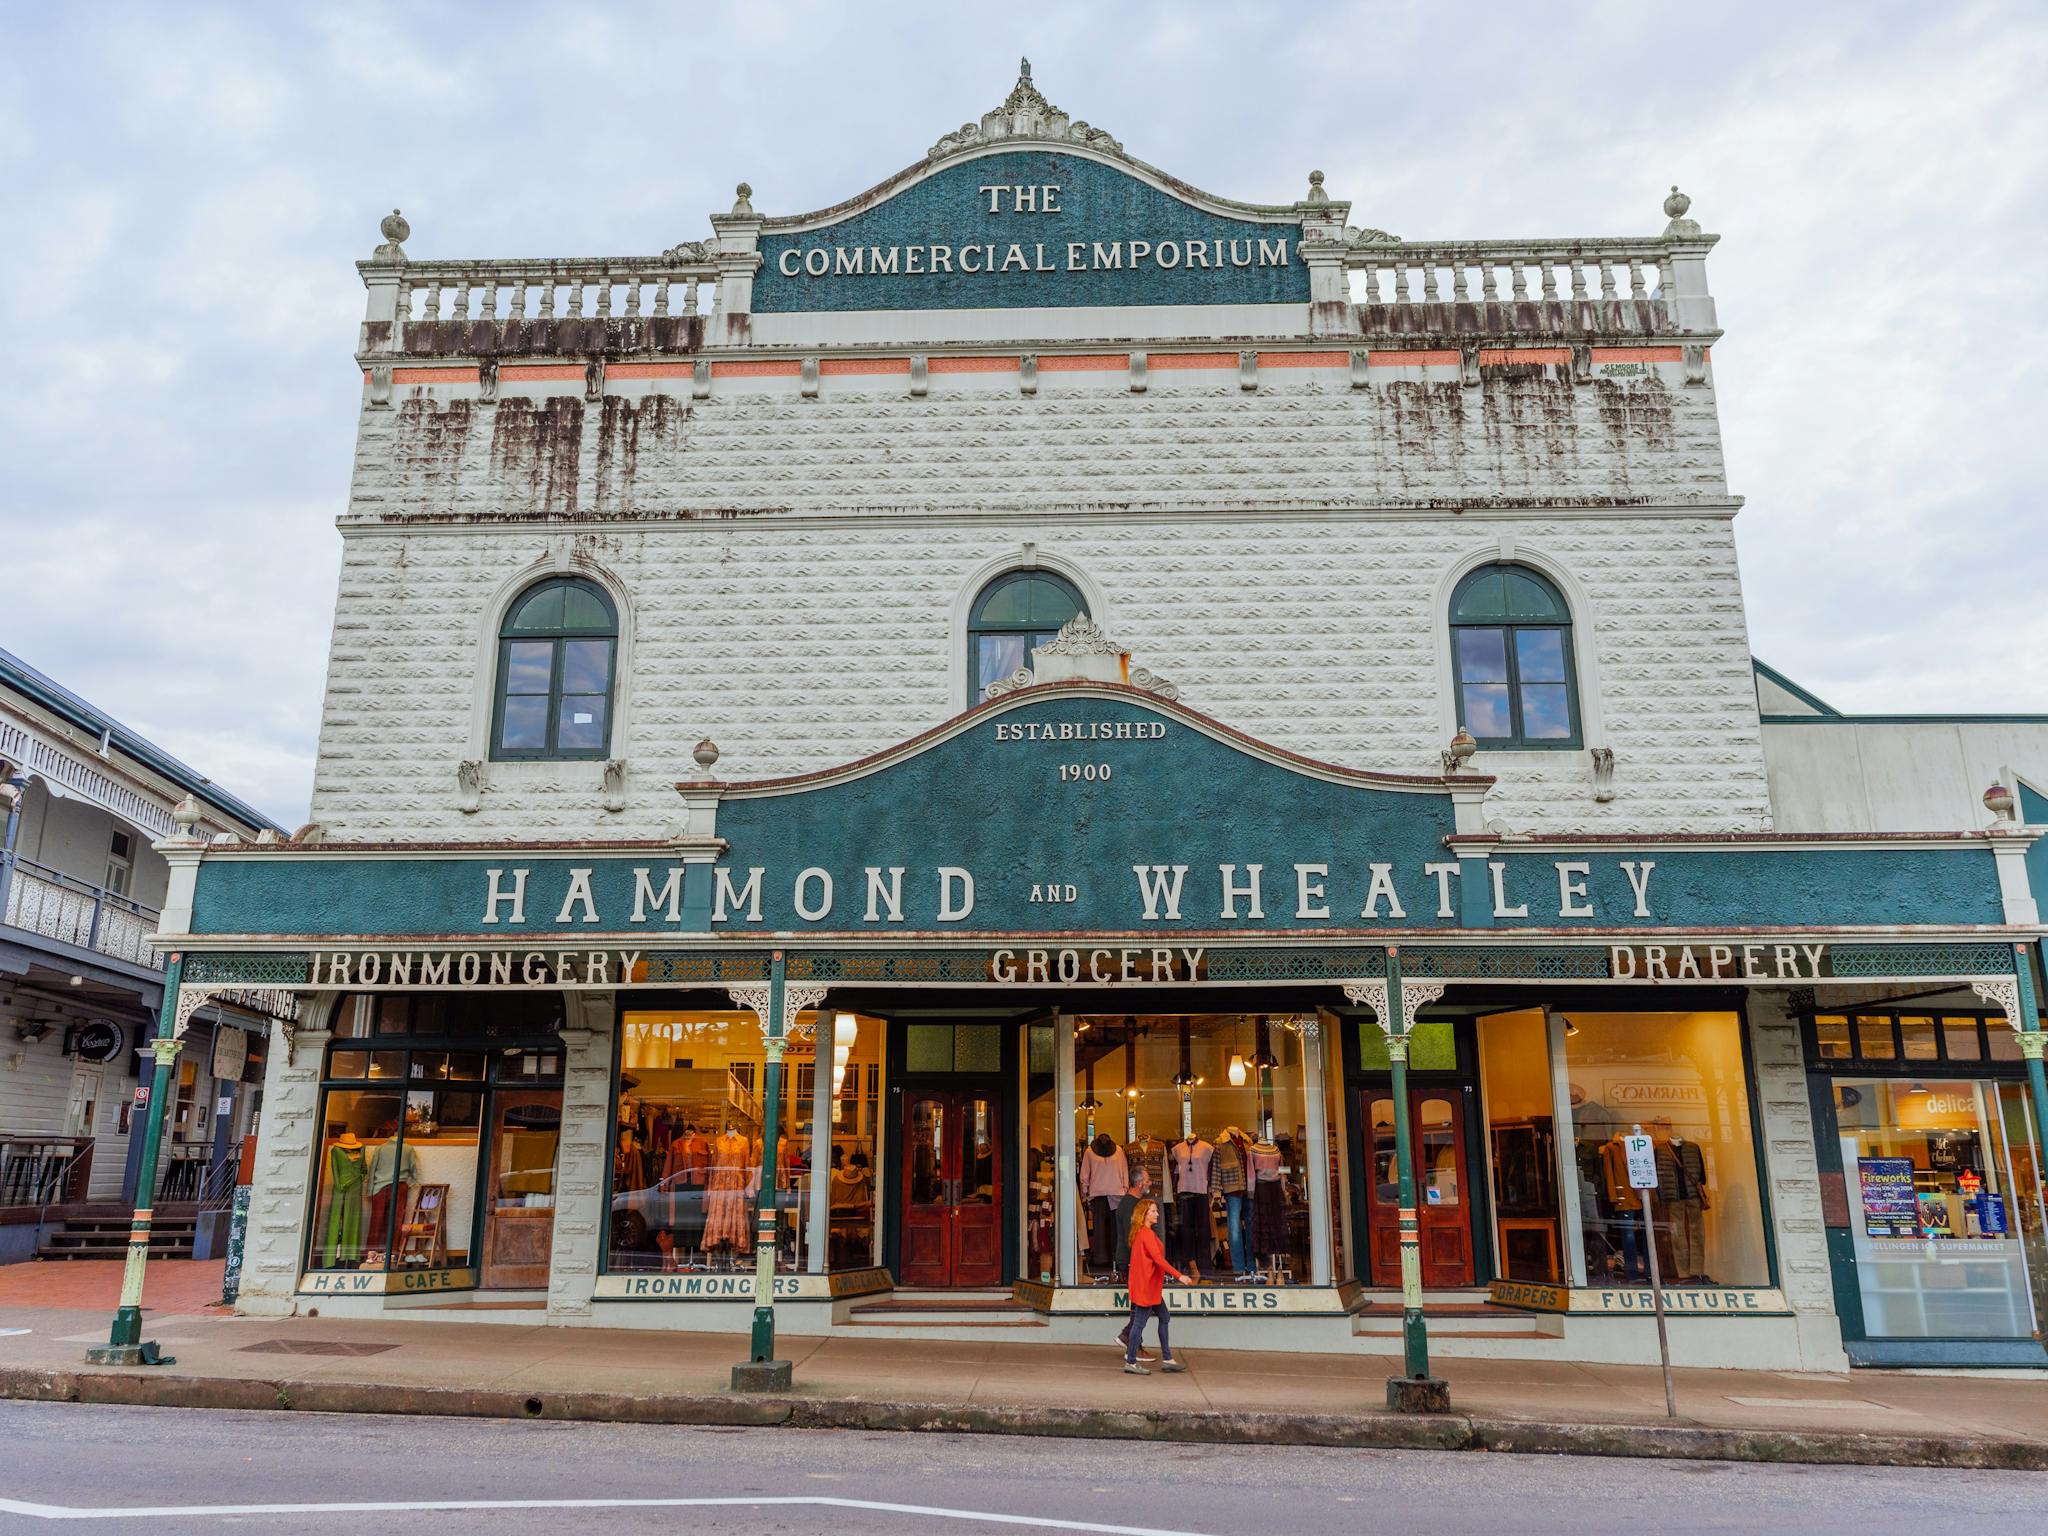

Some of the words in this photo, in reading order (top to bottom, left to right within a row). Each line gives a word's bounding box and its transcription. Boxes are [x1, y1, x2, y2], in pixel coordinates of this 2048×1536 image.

[980, 185, 1061, 213] THE
[778, 243, 1056, 277] COMMERCIAL
[1067, 239, 1289, 271] EMPORIUM
[995, 722, 1167, 741] ESTABLISHED
[1059, 763, 1112, 781] 1900
[482, 866, 975, 923] HAMMOND
[1029, 884, 1077, 902] AND
[1133, 861, 1656, 920] WHEATLEY
[311, 951, 641, 985] IRONMONGERY
[991, 948, 1205, 983] GROCERY
[1610, 944, 1824, 981] DRAPERY
[1631, 1138, 1647, 1152] 1P
[1862, 1172, 1911, 1184] Fireworks
[1941, 1242, 2005, 1252] SUPERMARKET
[314, 1275, 329, 1289] H
[333, 1276, 346, 1290] &
[353, 1275, 373, 1289] W
[625, 1278, 800, 1295] IRONMONGRS
[1114, 1291, 1279, 1309] MLINERS
[1496, 1284, 1559, 1306] DRAPERS
[1601, 1292, 1760, 1309] FURNITURE
